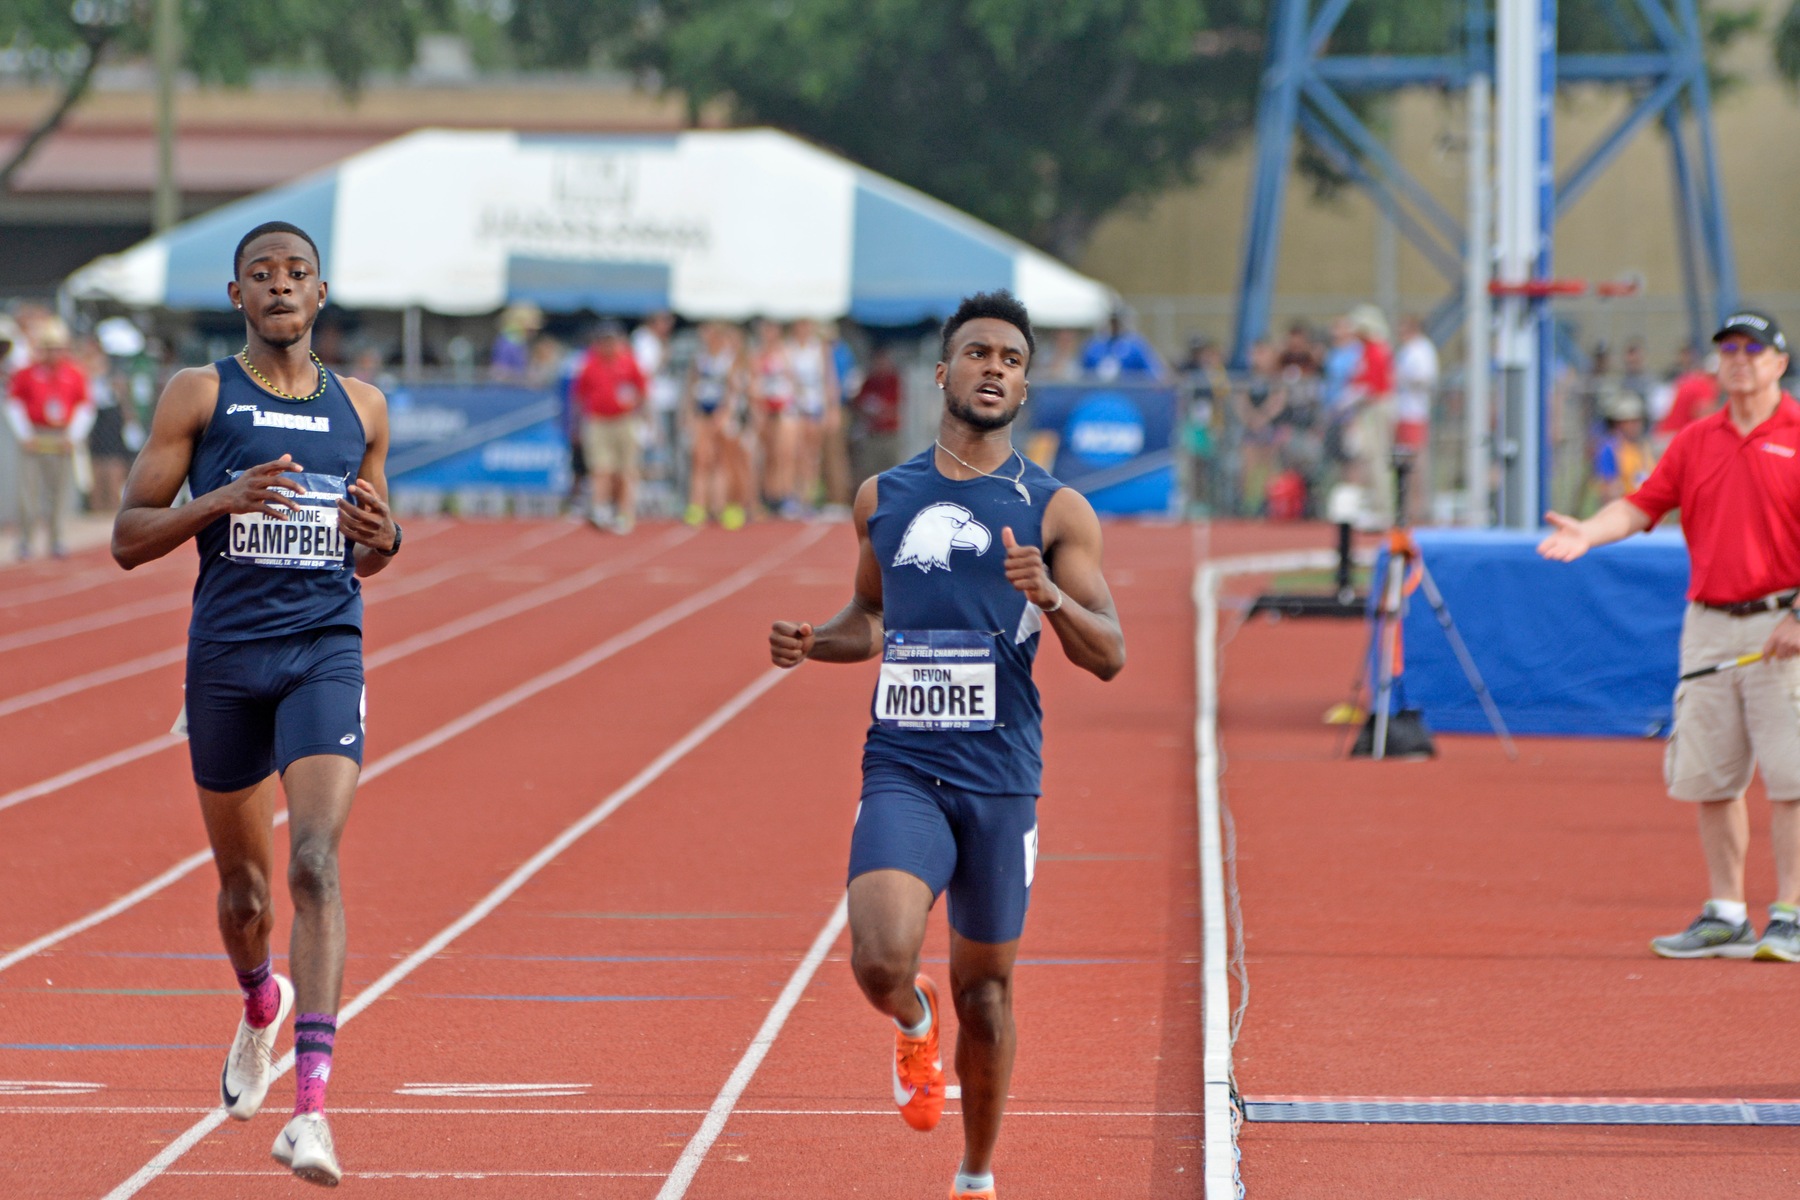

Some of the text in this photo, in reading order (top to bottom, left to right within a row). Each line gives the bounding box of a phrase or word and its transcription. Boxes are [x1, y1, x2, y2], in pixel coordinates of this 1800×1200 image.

[252, 410, 330, 432] LINCOLN
[232, 522, 344, 558] CAMPBELL
[916, 649, 933, 657] FIELD
[933, 649, 990, 657] CHAMPIONSHIPS
[913, 669, 951, 682] DEVON
[886, 684, 985, 716] MOORE
